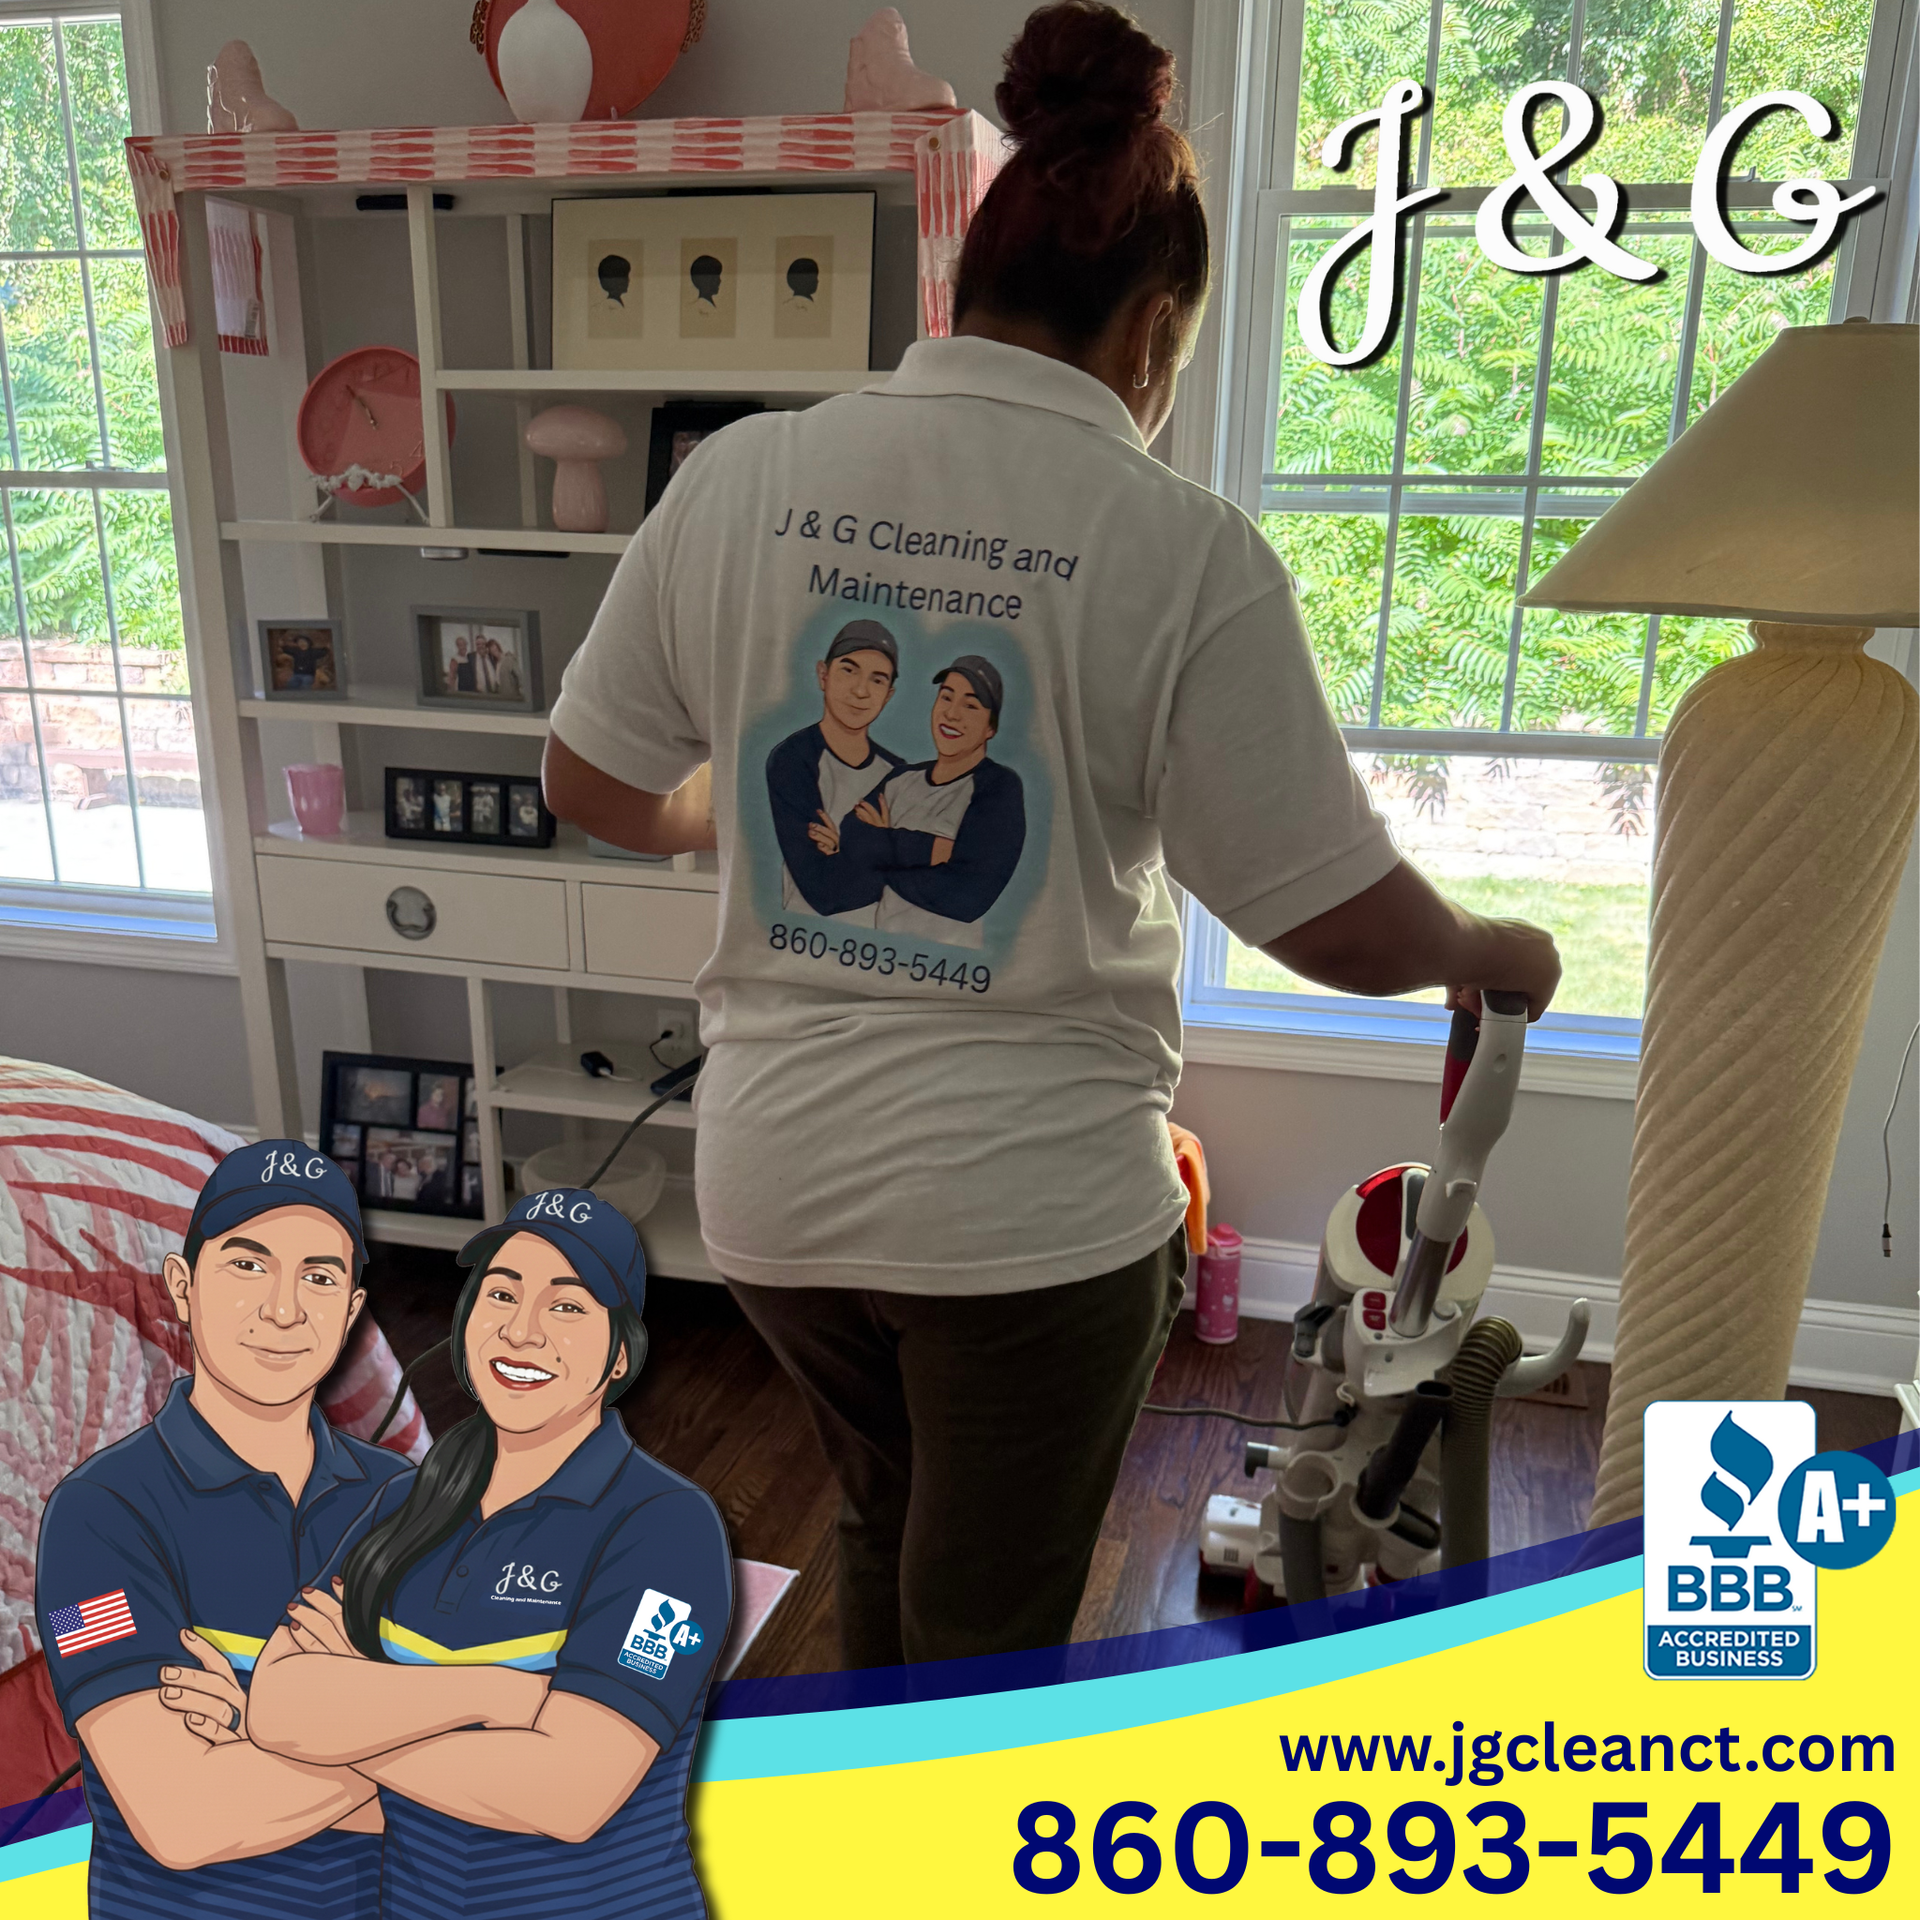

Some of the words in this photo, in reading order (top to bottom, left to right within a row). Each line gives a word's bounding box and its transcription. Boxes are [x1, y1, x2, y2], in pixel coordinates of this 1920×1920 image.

[774, 508, 793, 537] J
[800, 510, 822, 539] &
[833, 514, 858, 545] G
[868, 520, 1009, 571] Cleaning
[1012, 548, 1079, 582] and
[808, 564, 1023, 620] Maintenance
[769, 923, 991, 994] 860-893-5449
